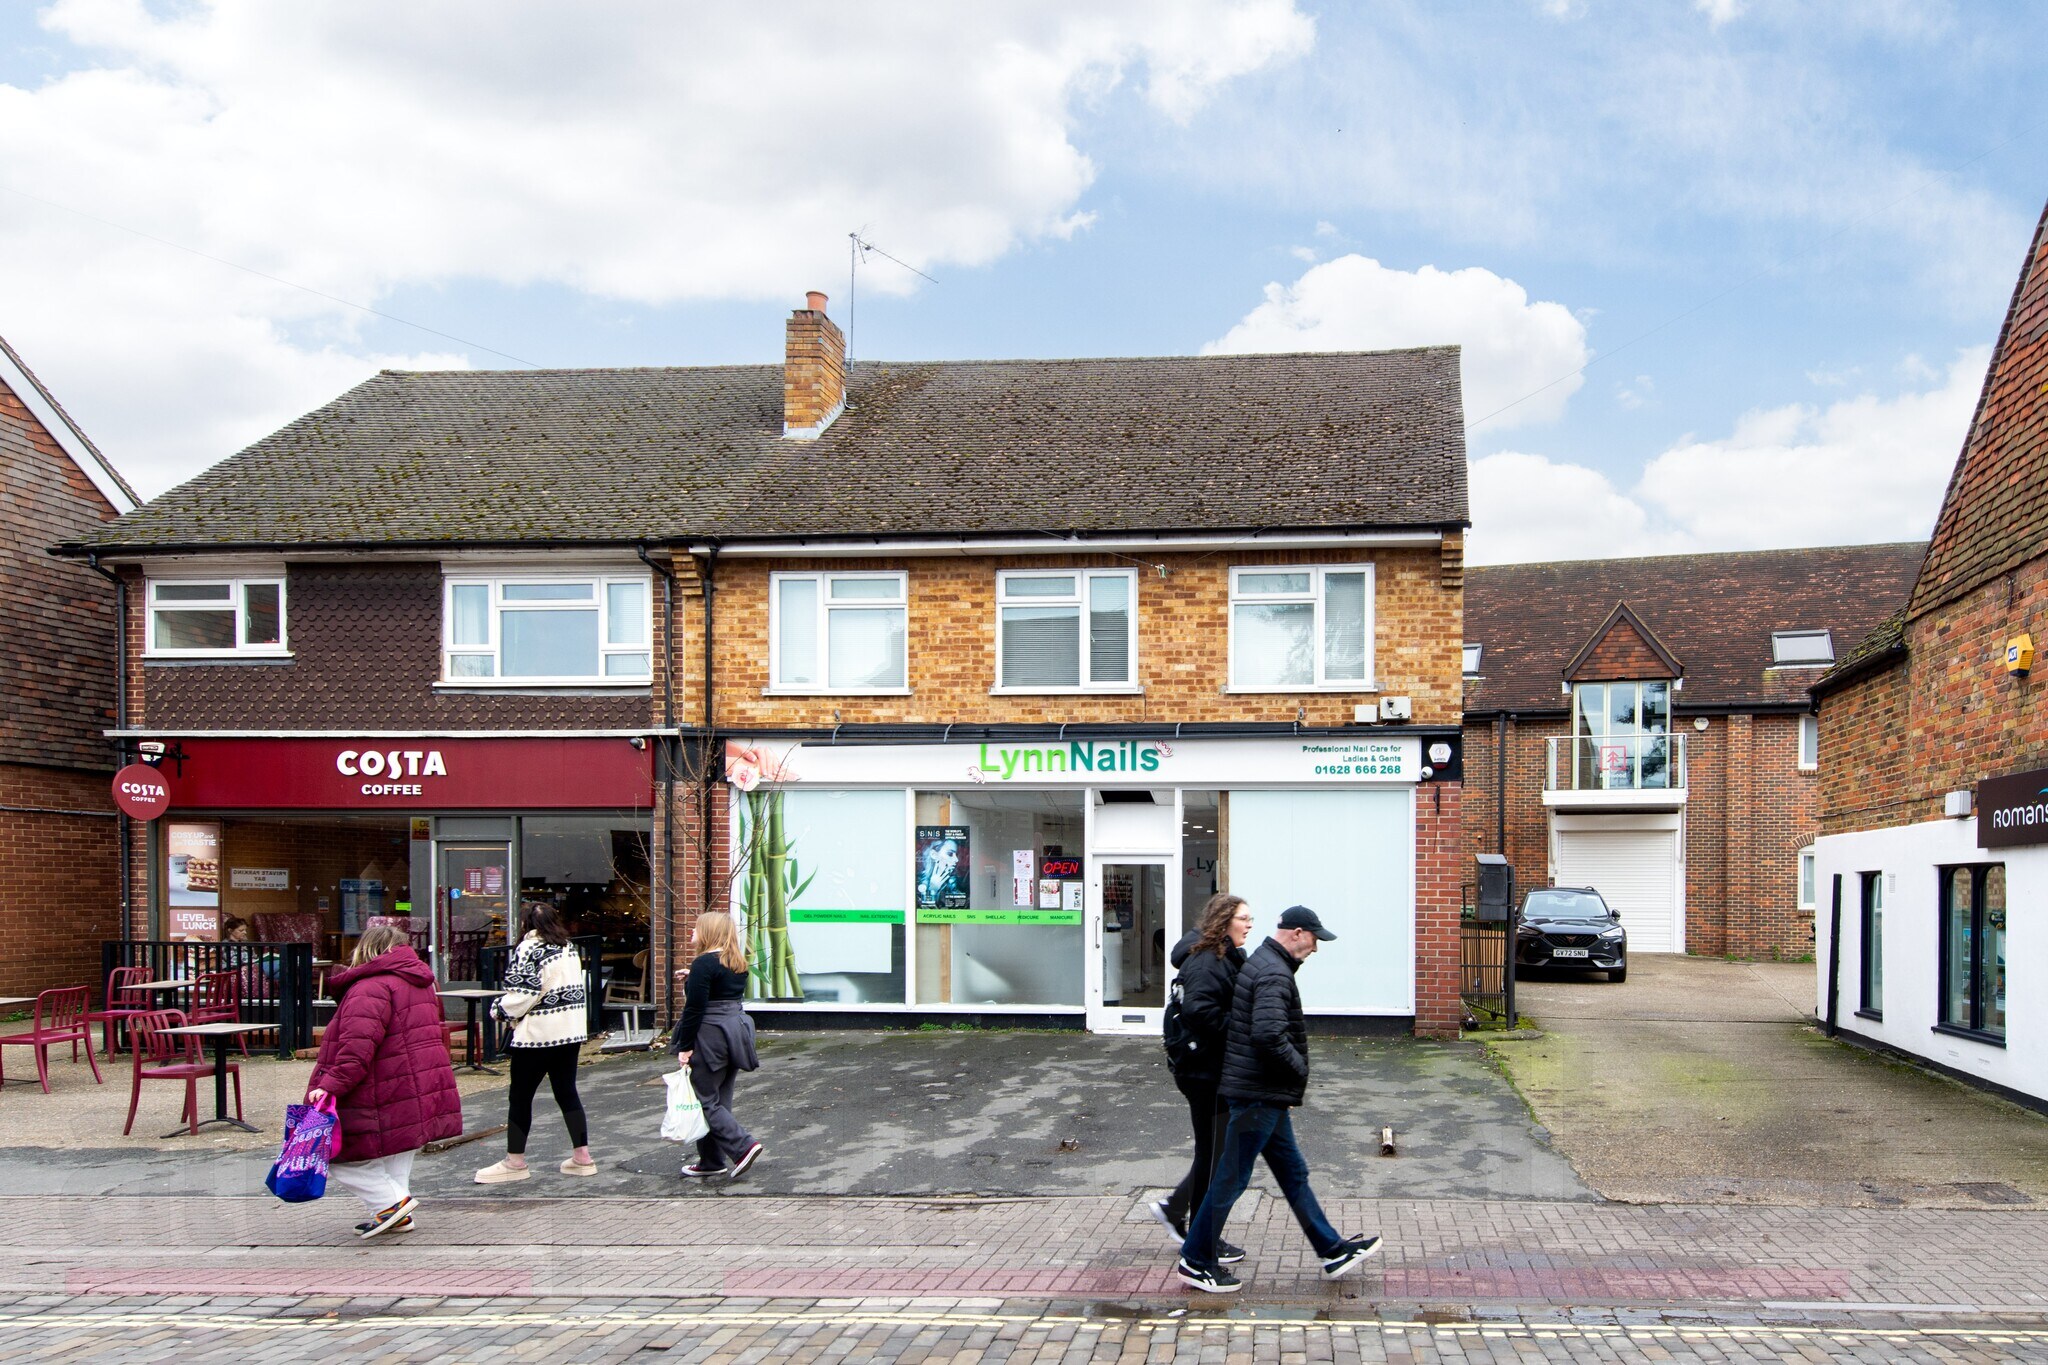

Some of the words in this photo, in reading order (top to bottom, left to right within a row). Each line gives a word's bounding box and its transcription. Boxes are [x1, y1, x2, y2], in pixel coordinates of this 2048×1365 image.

[336, 750, 448, 780] COSTA
[1314, 766, 1350, 774] 01628
[1355, 766, 1377, 774] 666
[1380, 765, 1401, 774] 268
[121, 782, 165, 796] COSTA
[361, 784, 422, 795] COFFEE
[1043, 862, 1078, 874] OPEN
